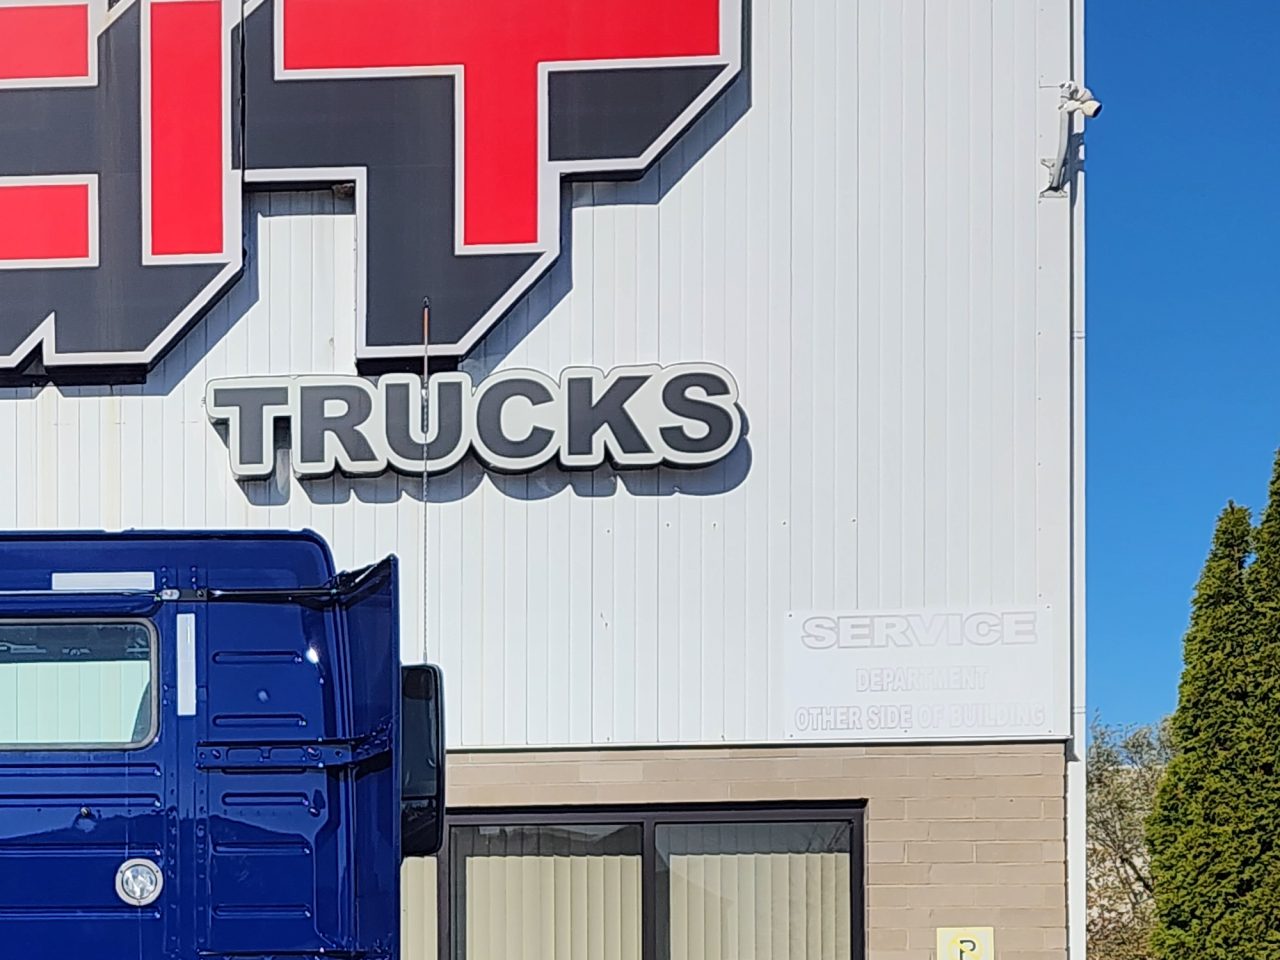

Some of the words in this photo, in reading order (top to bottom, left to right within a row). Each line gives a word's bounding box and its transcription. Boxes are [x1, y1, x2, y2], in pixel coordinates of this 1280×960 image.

[210, 366, 738, 472] TRUCKS
[801, 611, 1037, 650] SERVICE
[856, 666, 989, 692] DEPARTMENT
[794, 706, 863, 731] OTHER
[868, 704, 913, 730] SIDE
[919, 703, 945, 728] OF
[950, 702, 1046, 729] BUILDING
